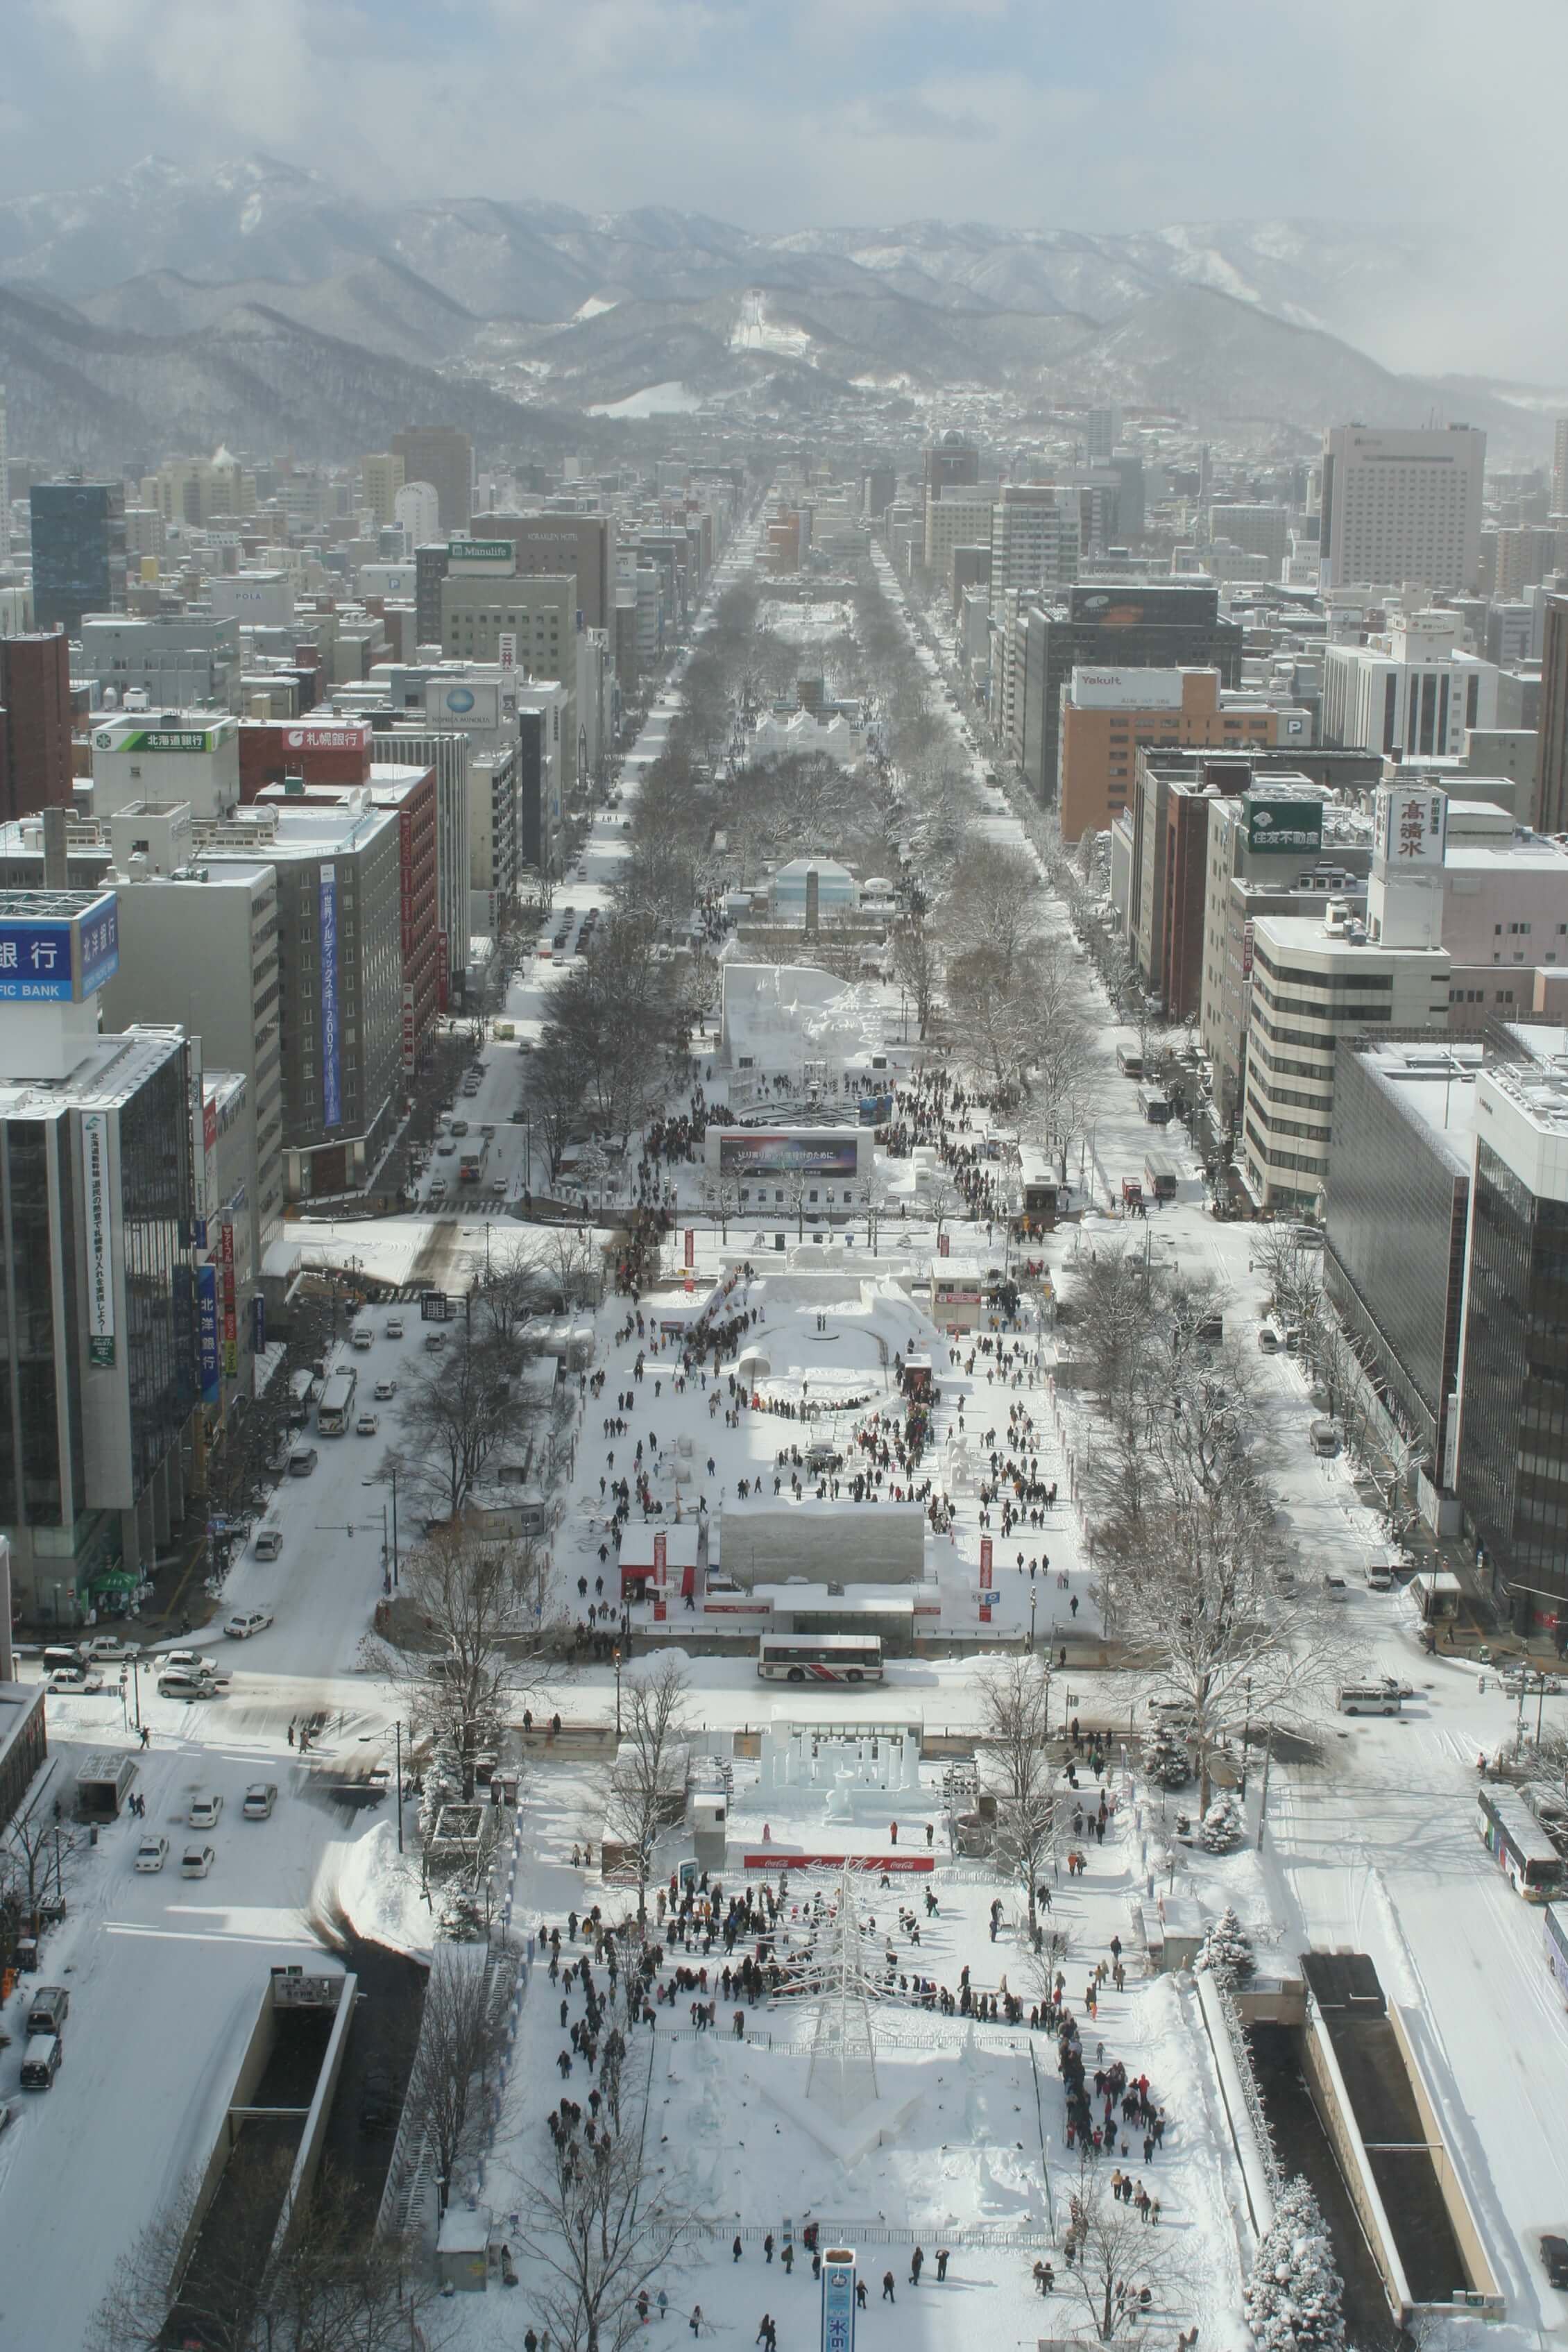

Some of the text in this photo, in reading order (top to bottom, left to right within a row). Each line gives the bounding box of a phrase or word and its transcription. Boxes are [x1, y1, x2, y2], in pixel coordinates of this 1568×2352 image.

[561, 532, 578, 541] HOTEL
[465, 546, 506, 556] Manulife
[502, 638, 513, 670] 三井
[1082, 676, 1122, 685] Yakult
[1288, 721, 1302, 733] P
[147, 734, 203, 746] 北海道銀行
[306, 731, 357, 747] 札幌銀行
[1252, 831, 1319, 844] 住友不動産
[0, 941, 58, 969] 銀行
[22, 985, 60, 996] BANK
[201, 1297, 215, 1370] 北洋銀行
[765, 1859, 789, 1868] Coca-Cola
[890, 1861, 915, 1870] Coca-Cola
[829, 2319, 847, 2352] 氷の
